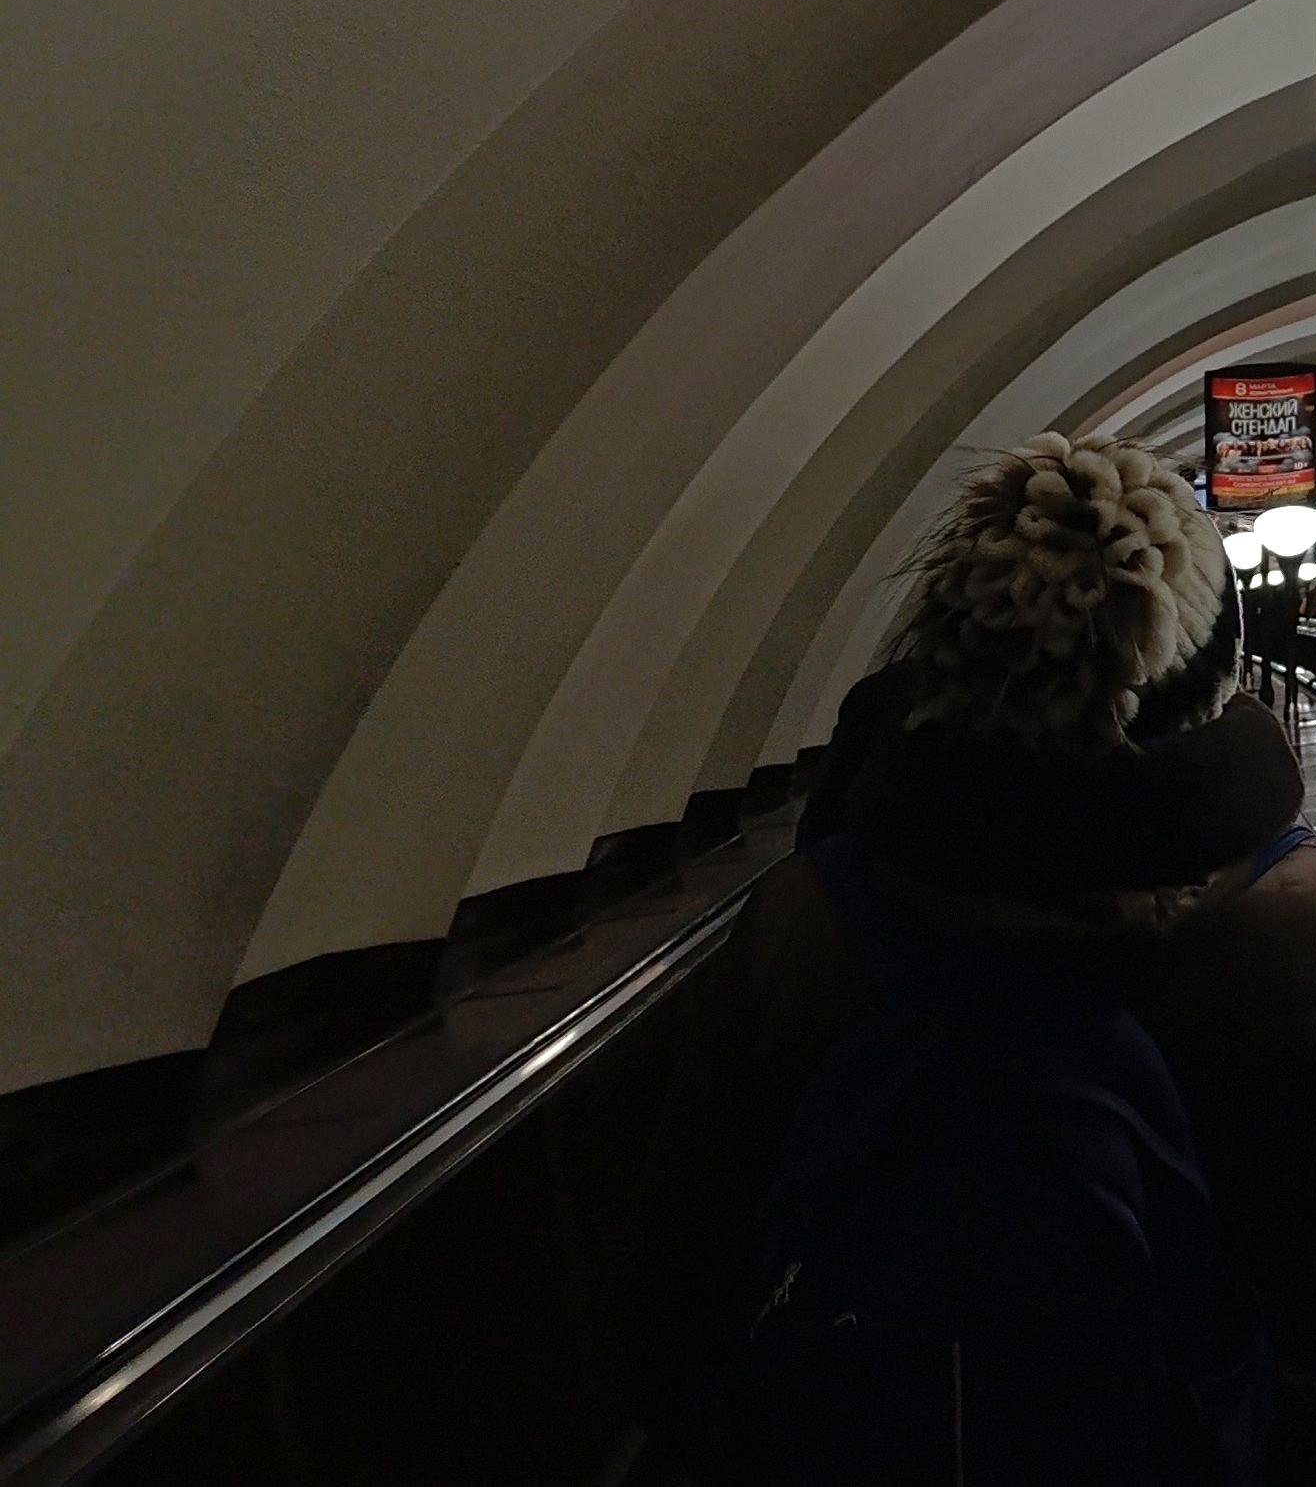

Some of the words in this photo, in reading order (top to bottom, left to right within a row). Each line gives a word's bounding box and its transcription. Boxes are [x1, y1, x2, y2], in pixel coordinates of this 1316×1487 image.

[1235, 382, 1247, 396] 8
[1228, 398, 1298, 419] ЖЕНСКИЙ
[1231, 417, 1296, 435] СТЕНДАП
